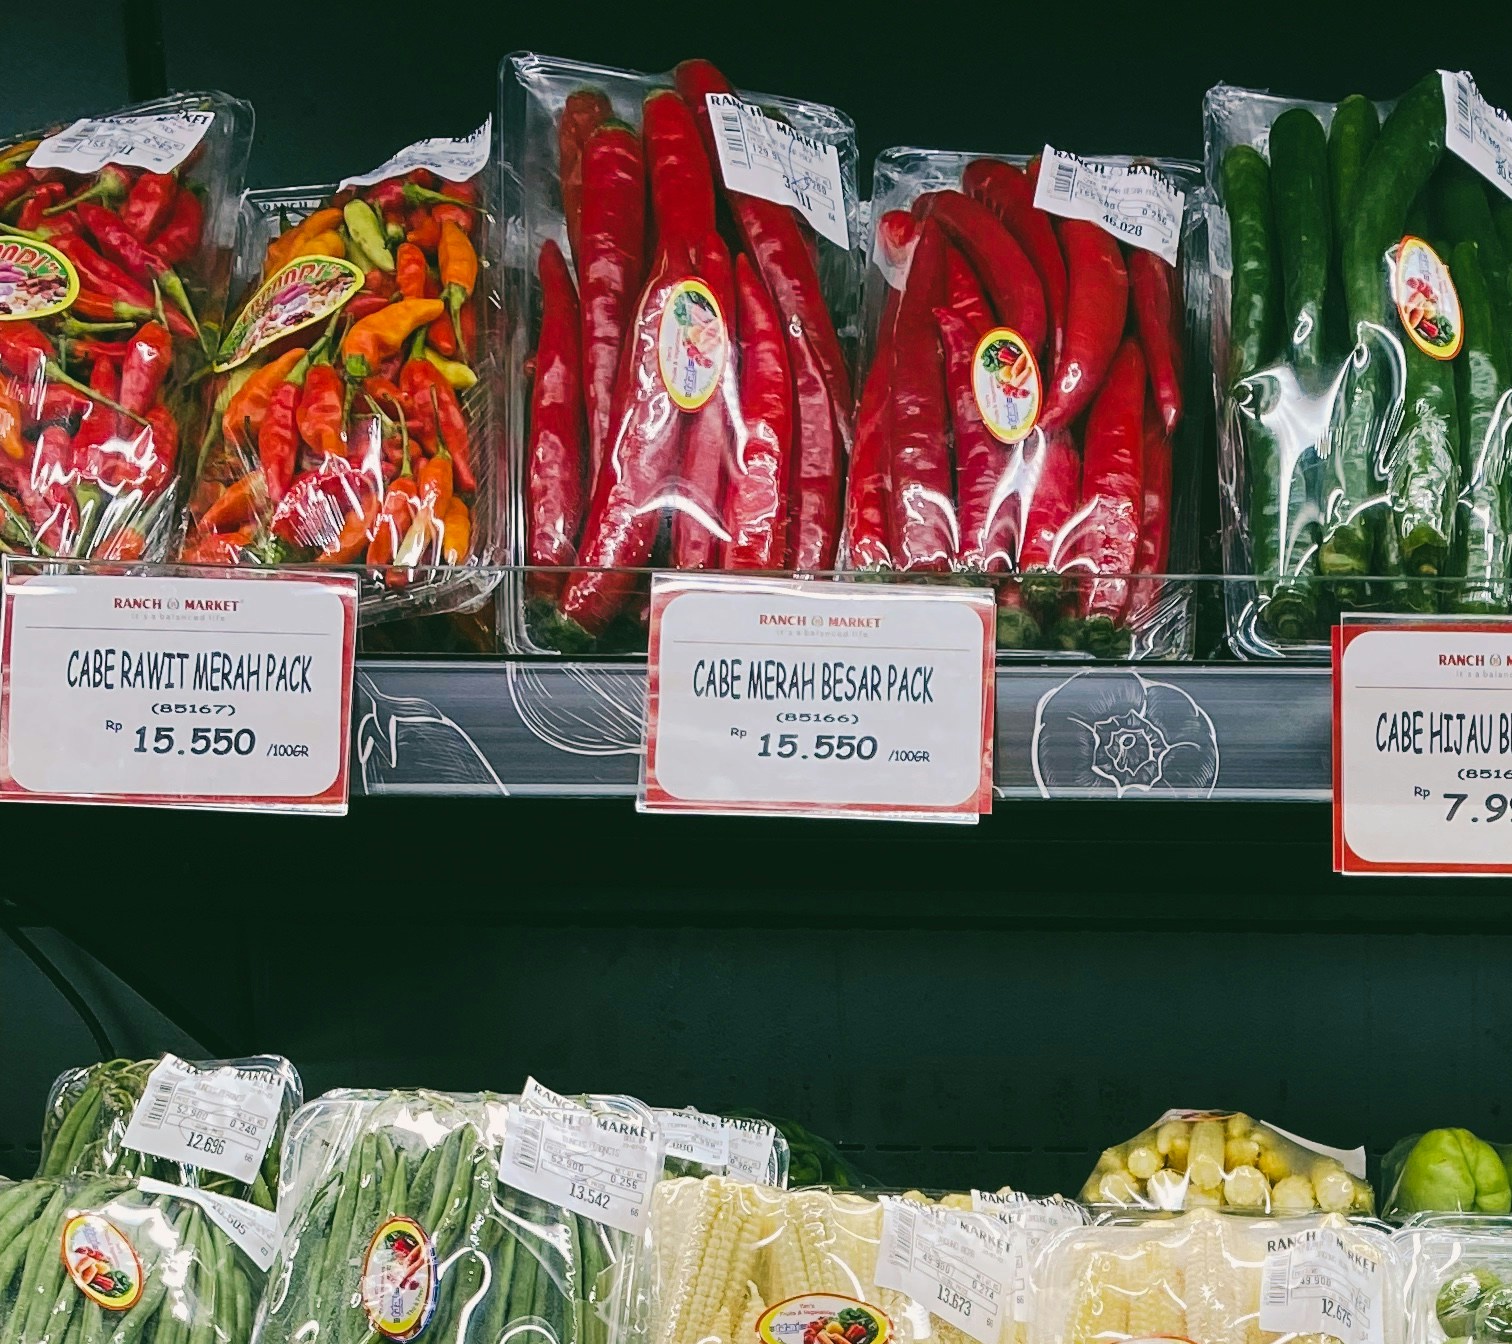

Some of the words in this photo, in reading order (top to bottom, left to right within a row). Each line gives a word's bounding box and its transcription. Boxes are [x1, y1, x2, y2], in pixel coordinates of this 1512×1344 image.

[114, 598, 162, 611] RANCH
[184, 600, 240, 612] MARKET
[759, 614, 807, 626] RANCH
[828, 616, 880, 628] MARKET
[67, 649, 116, 690] CABE
[121, 650, 189, 691] RAWIT
[193, 652, 260, 692] MERAH
[266, 654, 313, 693] PACK
[1439, 654, 1485, 667] RANCH
[693, 658, 742, 700] CABE
[748, 659, 815, 702] MERAH
[821, 661, 882, 702] BESAR
[888, 664, 934, 704] PACK
[152, 703, 236, 716] (85167)
[776, 712, 859, 725] (85166)
[105, 719, 123, 733] Rp
[133, 725, 256, 756] 15.550
[266, 744, 309, 758] /100GR
[730, 727, 747, 739] Rp
[757, 733, 878, 761] 15.550
[888, 750, 931, 763] /100GR
[1376, 710, 1424, 754] CABE
[1430, 712, 1494, 755] HIJAU
[1414, 786, 1431, 800] Rp
[186, 1131, 227, 1156] 12.696
[570, 1183, 611, 1210] 13.542
[937, 1284, 973, 1317] 13.673
[1321, 1298, 1353, 1329] 12.675
